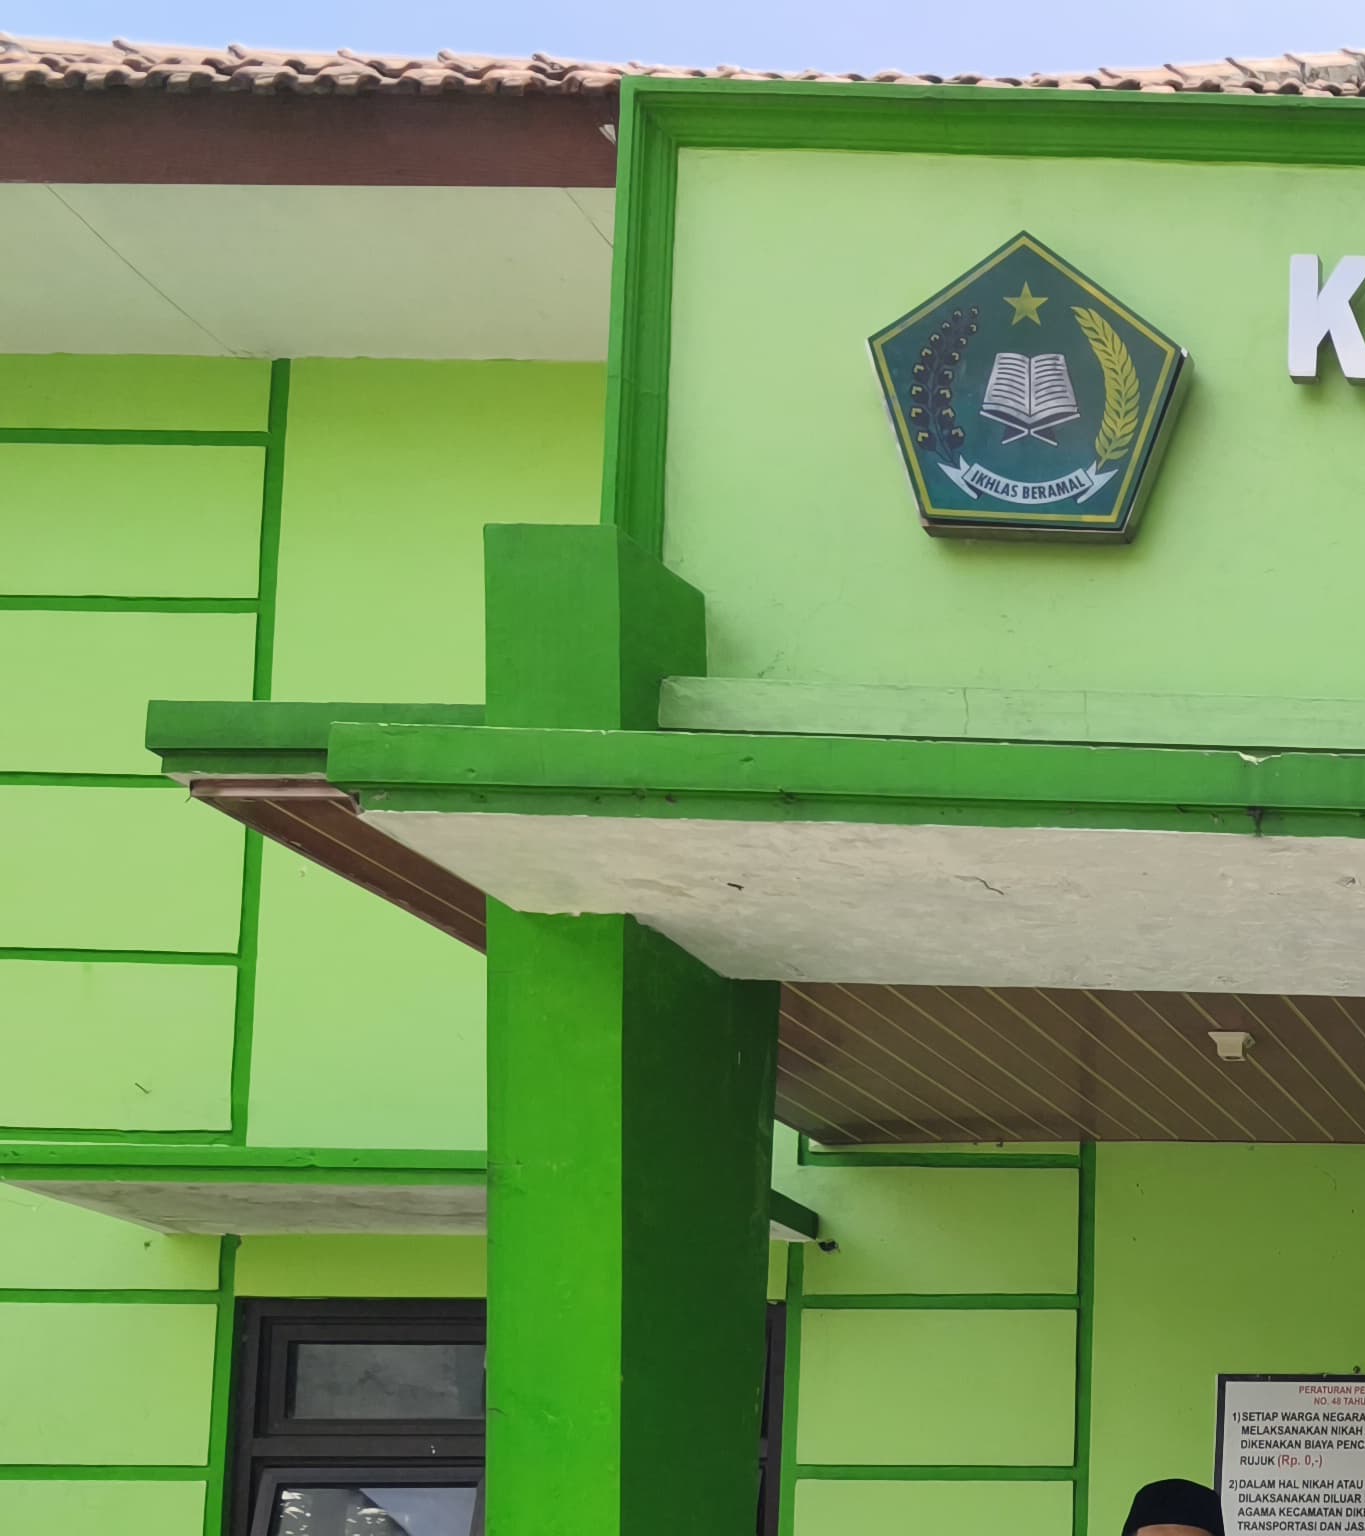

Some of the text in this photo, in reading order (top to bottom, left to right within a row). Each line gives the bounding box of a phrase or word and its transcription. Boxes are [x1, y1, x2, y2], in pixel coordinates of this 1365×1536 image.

[971, 470, 1086, 500] IKHLAS BERAMAL
[1298, 1386, 1352, 1395] PERATURAN
[1313, 1397, 1330, 1406] NO.
[1280, 1412, 1320, 1422] WARGA
[1322, 1412, 1365, 1422] NEGARA
[1241, 1425, 1328, 1435] MELAKSANAKAN
[1330, 1425, 1363, 1436] NIKAH
[1240, 1439, 1302, 1449] DIKENAKAN
[1304, 1439, 1334, 1450] BIAYA
[1240, 1455, 1275, 1466] RUJUK
[1277, 1454, 1300, 1468] (Rp.
[1278, 1479, 1299, 1489] HAL
[1302, 1479, 1334, 1489] NIKAH
[1336, 1479, 1364, 1489] ATAU
[1238, 1493, 1321, 1503] DILAKSANAKAN
[1323, 1493, 1362, 1503] DILUAR
[1237, 1507, 1277, 1517] AGAMA
[1279, 1507, 1343, 1517] KECAMATAN
[1237, 1521, 1318, 1531] TRANSPORTASI
[1320, 1521, 1342, 1531] DAN
